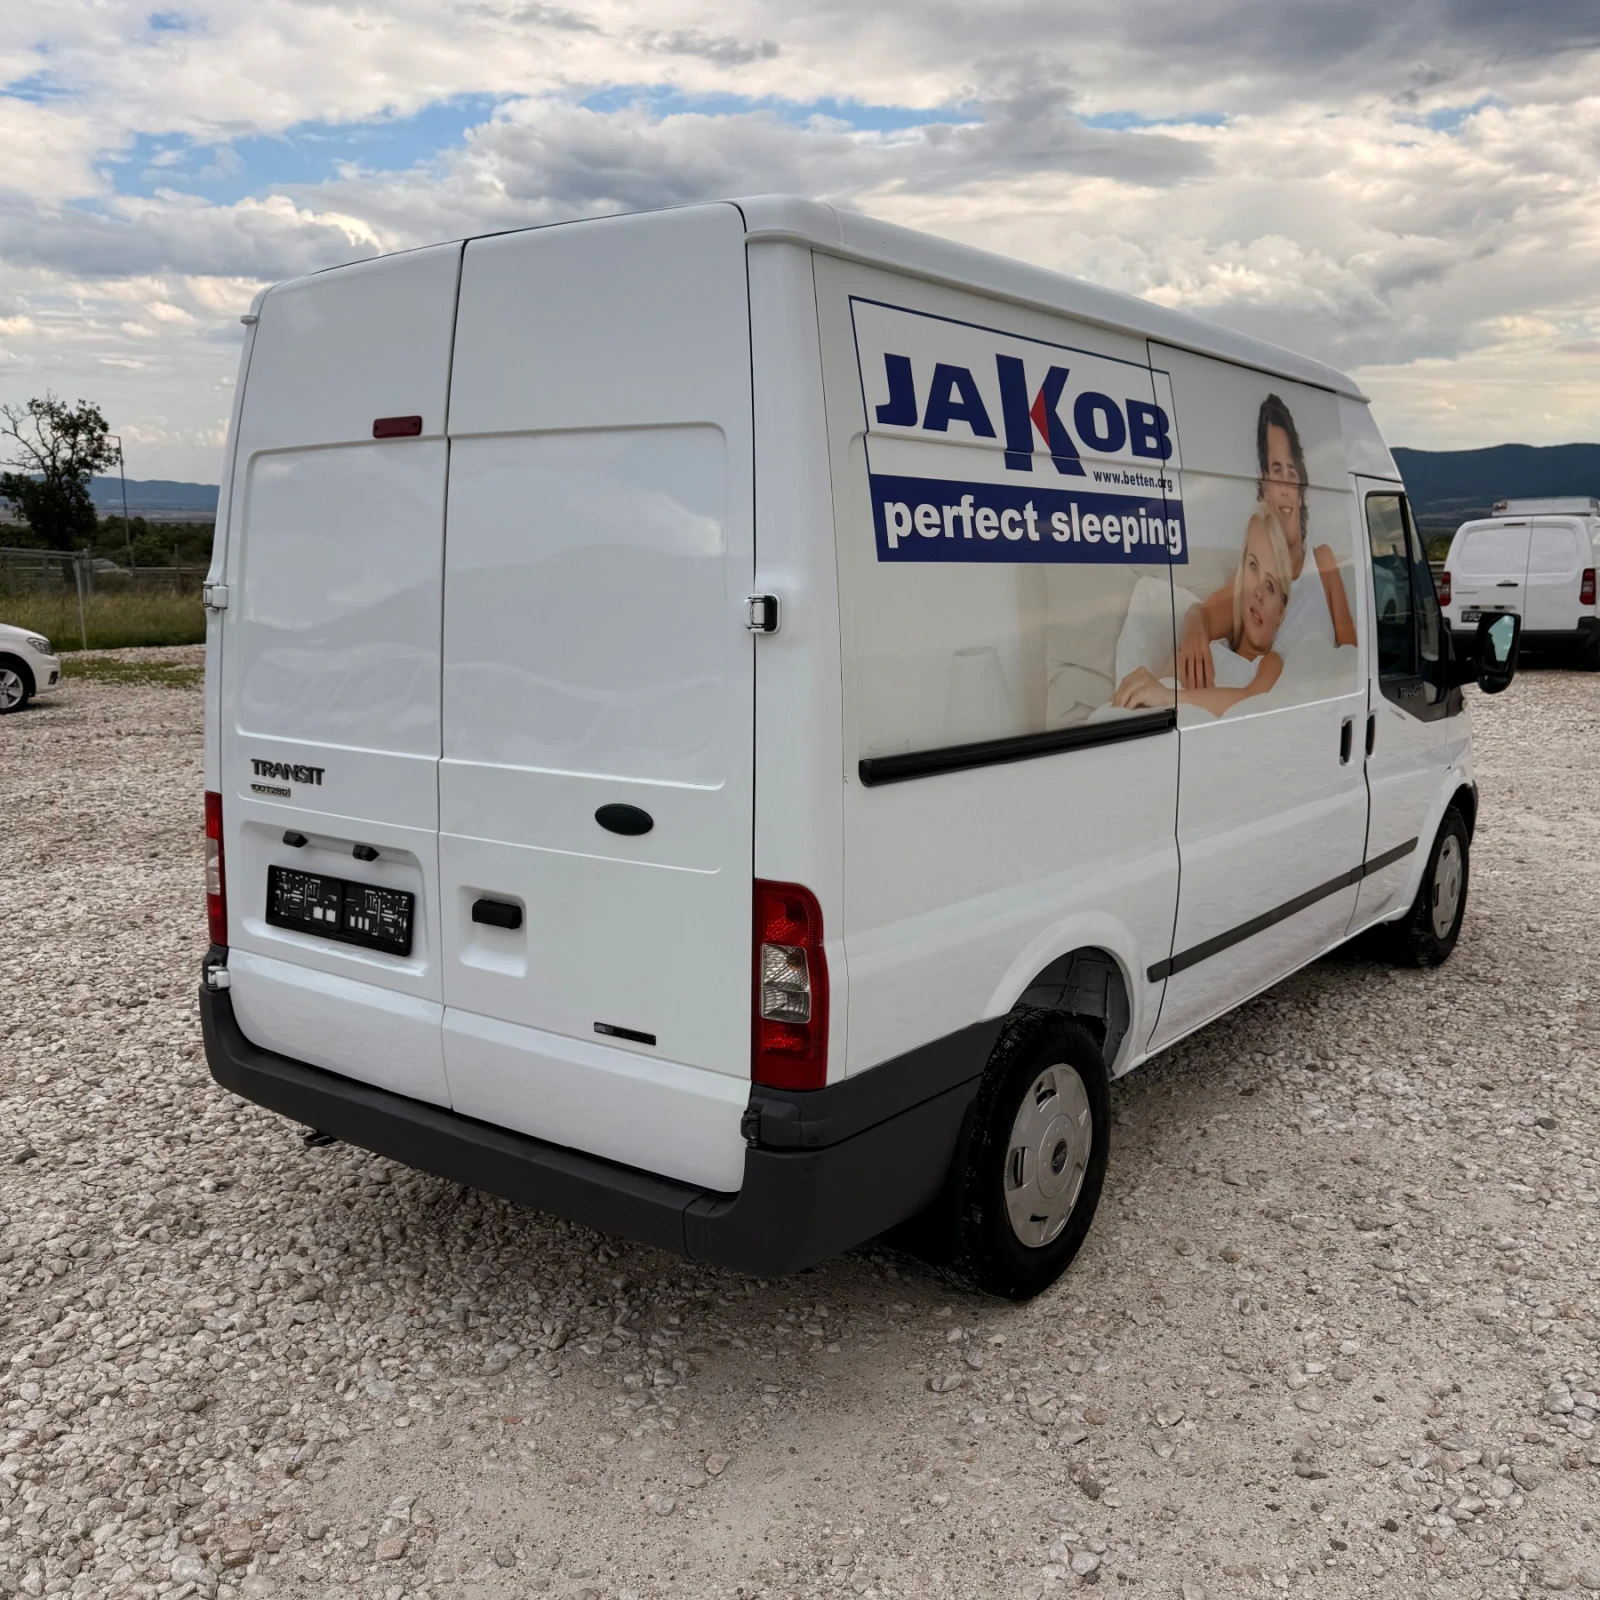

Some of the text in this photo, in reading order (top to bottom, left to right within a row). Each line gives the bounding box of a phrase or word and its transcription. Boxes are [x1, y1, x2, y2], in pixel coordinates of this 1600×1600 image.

[875, 353, 1173, 477] JAKOB
[1093, 470, 1173, 493] www.betten.org
[884, 494, 1183, 556] perfect sleeping
[250, 758, 325, 785] TRANSIT
